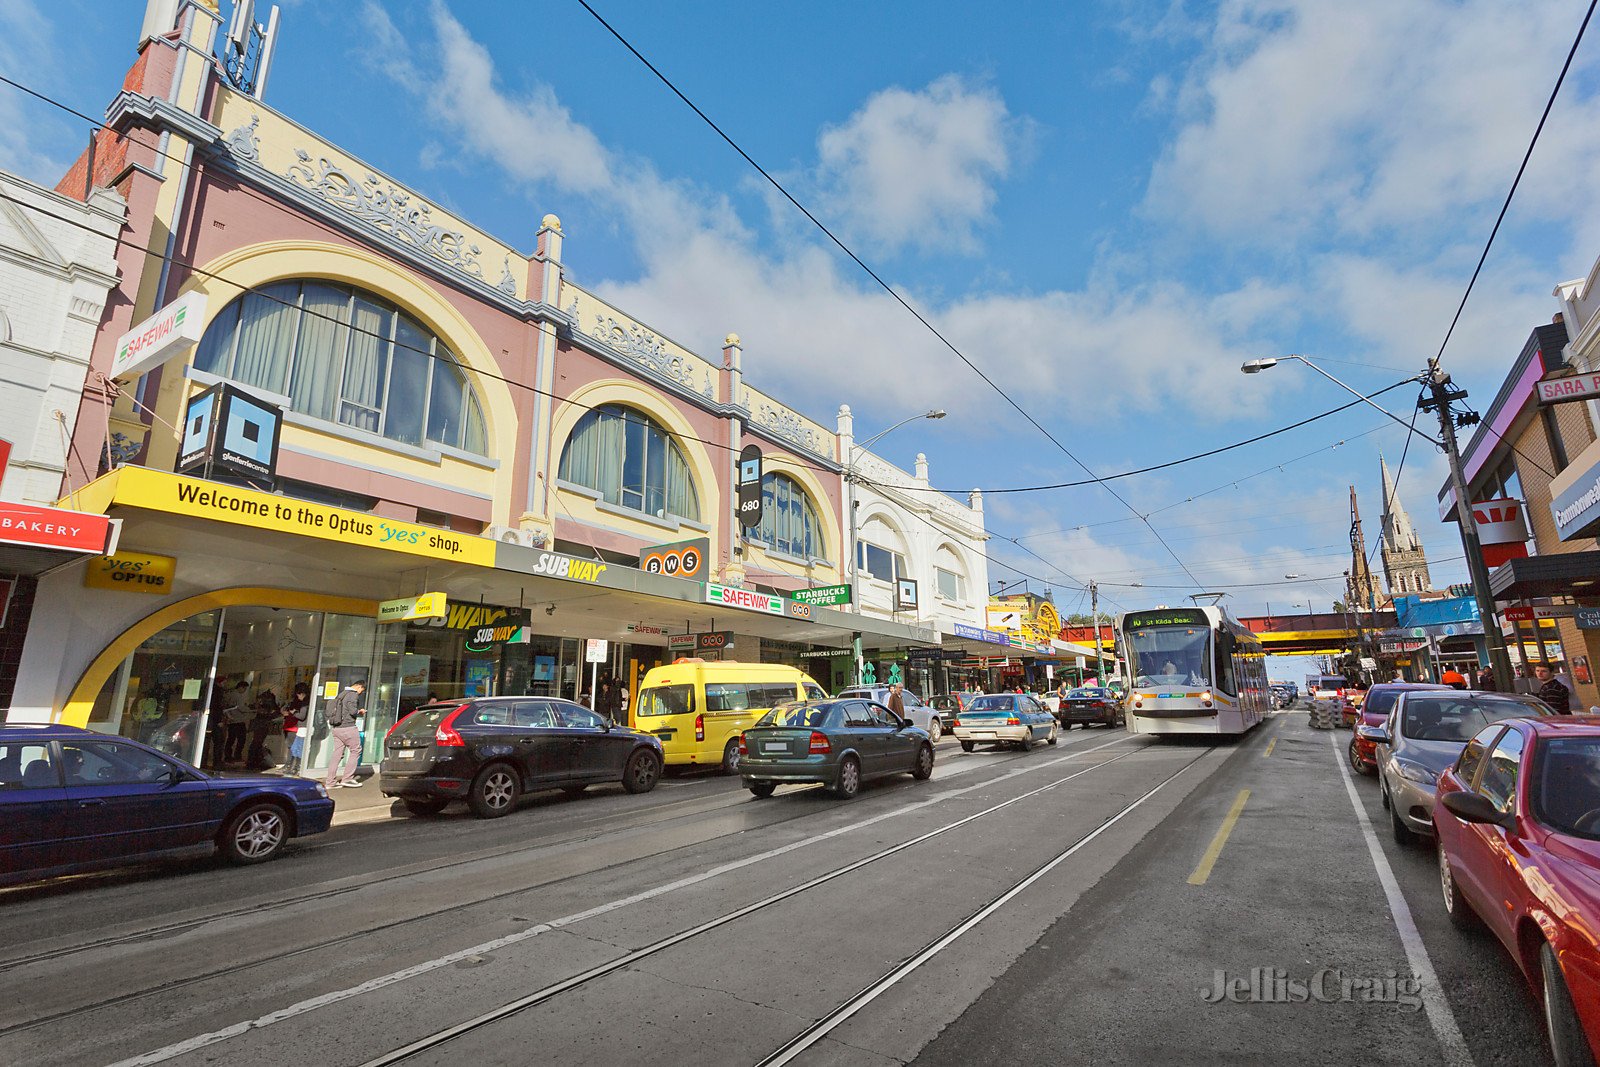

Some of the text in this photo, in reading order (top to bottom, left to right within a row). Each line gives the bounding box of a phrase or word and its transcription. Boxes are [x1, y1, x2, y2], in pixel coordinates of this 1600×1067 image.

[126, 312, 176, 358] SAFEWAY
[1543, 379, 1586, 398] SARA
[741, 499, 759, 512] 680
[1, 517, 81, 537] BAKERY
[177, 482, 270, 517] Welcome
[275, 503, 292, 521] to
[298, 507, 324, 527] the
[328, 513, 374, 537] Optus
[429, 535, 463, 555] shop.
[533, 553, 607, 583] SUBWAY
[112, 571, 164, 586] OPTUS
[722, 588, 770, 610] SAFEWAY
[796, 587, 845, 600] STARBUCKS
[805, 595, 836, 605] COFFEE
[473, 625, 518, 643] SUBWAY
[634, 626, 661, 635] SAFEWAY
[670, 635, 695, 644] SAFEWAY
